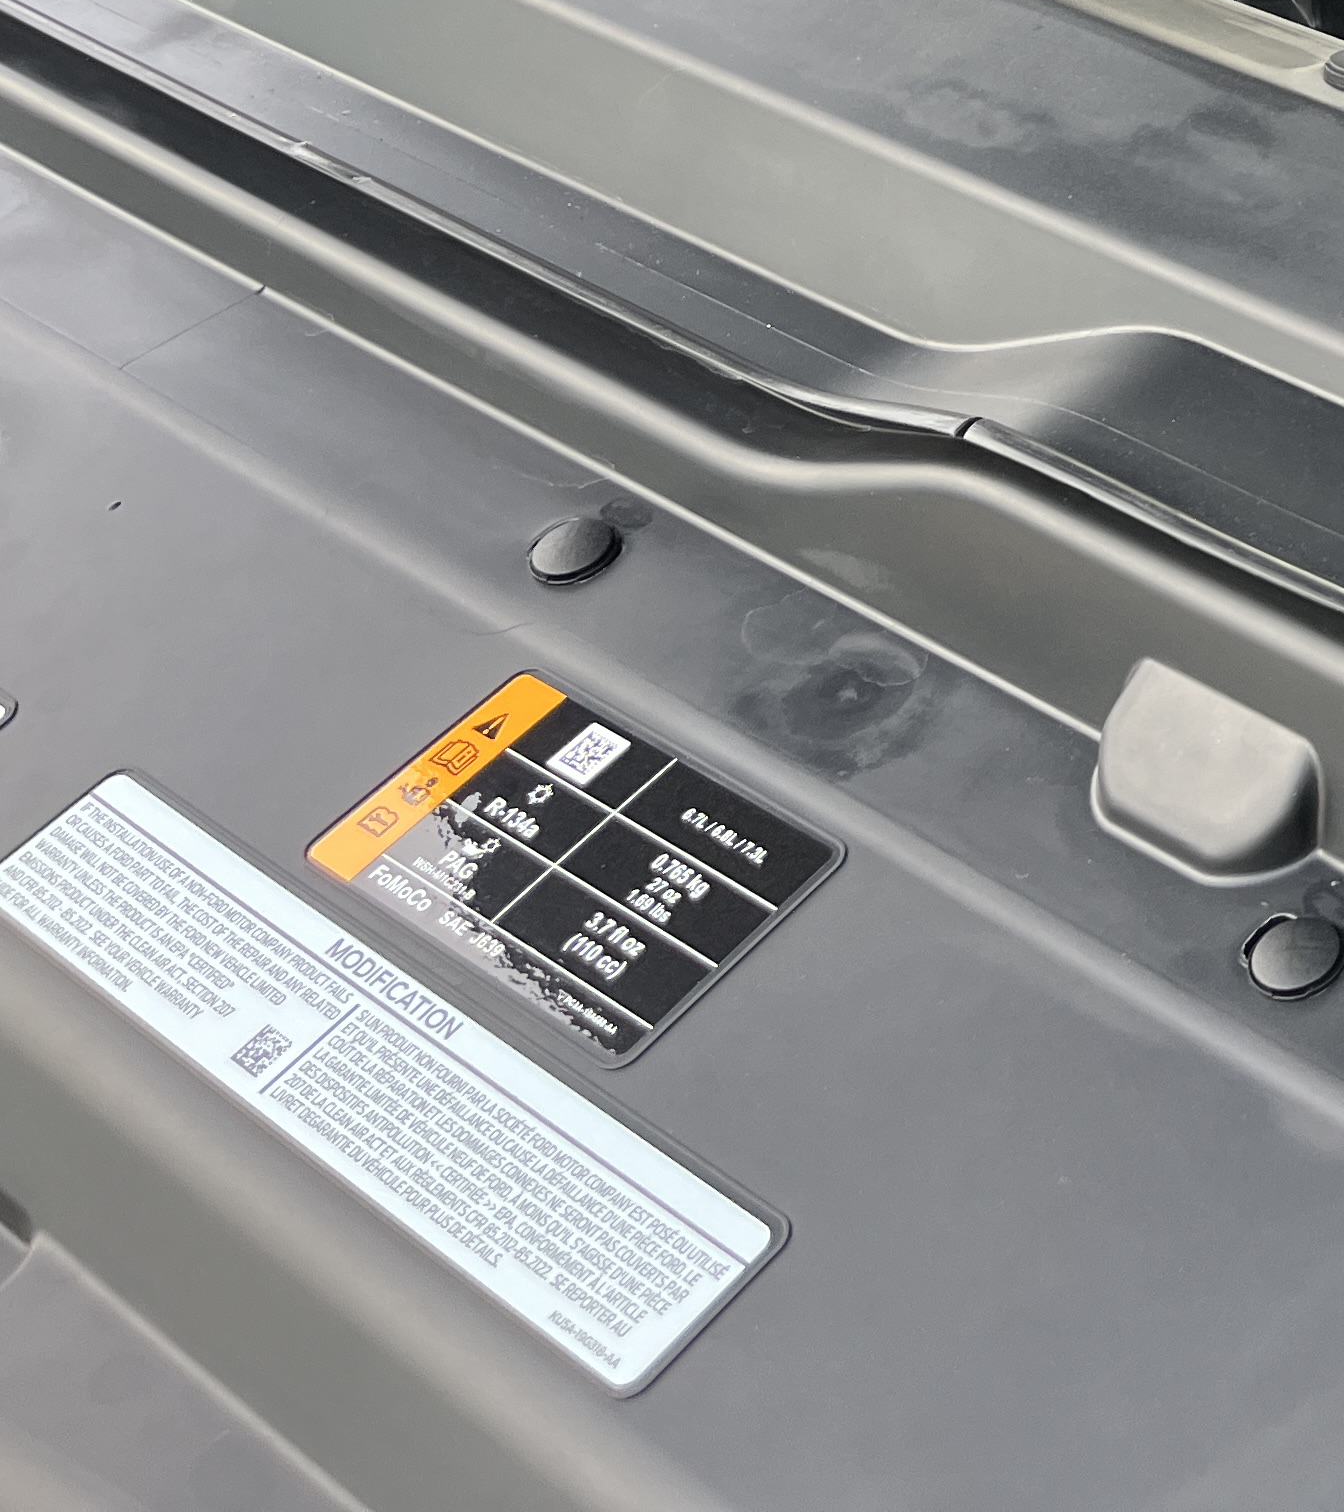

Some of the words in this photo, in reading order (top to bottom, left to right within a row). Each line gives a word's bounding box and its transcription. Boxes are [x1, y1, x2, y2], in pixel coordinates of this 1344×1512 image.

[438, 850, 479, 879] PAG
[484, 797, 542, 838] R-134a
[680, 807, 710, 828] 6.7L
[709, 825, 740, 845] 6.8L
[739, 842, 770, 863] 7.3L
[7, 891, 30, 910] FOR
[21, 904, 42, 922] ALL
[36, 913, 83, 952] WARRANTY
[34, 838, 81, 874] WARRANTY
[73, 868, 108, 896] UNLESS
[101, 888, 123, 908] THE
[115, 900, 158, 932] PRODUCT
[168, 940, 190, 960] EPA
[49, 825, 87, 855] DAMAGE
[79, 847, 102, 869] WILL
[95, 861, 120, 879] NOT
[121, 880, 161, 912] COVERED
[165, 913, 188, 932] THE
[179, 925, 208, 947] FORD
[199, 939, 226, 960] NEW
[219, 952, 258, 984] VEHICLE
[249, 976, 287, 1006] LIMITED
[65, 814, 83, 828] OR
[75, 822, 110, 849] CAUSES
[107, 846, 135, 868] FORD
[127, 861, 156, 882] PART
[176, 896, 200, 916] THE
[191, 908, 220, 930] COST
[222, 930, 246, 950] THE
[237, 942, 273, 970] REPAIR
[264, 963, 289, 982] AND
[282, 975, 308, 995] ANY
[298, 987, 342, 1021] RELATED
[79, 801, 95, 812] IF
[87, 806, 110, 825] THE
[168, 867, 187, 880] OF
[184, 879, 230, 914] NON-FORD
[222, 906, 257, 934] MOTOR
[250, 927, 295, 961] COMPANY
[287, 954, 332, 987] PRODUCT
[323, 980, 355, 1004] FAILS
[368, 863, 435, 912] FoMoCo
[438, 910, 474, 937] SAE
[468, 929, 505, 957] J639
[624, 889, 653, 910] 1.69
[648, 903, 673, 922] lbs
[645, 877, 666, 894] 27
[660, 888, 681, 903] oz
[649, 853, 694, 884] 0.765
[683, 875, 712, 899] kg
[2, 864, 26, 882] AND
[18, 875, 39, 893] CFR
[88, 929, 111, 948] SEE
[103, 940, 131, 964] YOUR
[124, 956, 162, 987] VEHICLE
[153, 979, 204, 1019] WARRANTY
[18, 850, 63, 886] EMISSIONS
[55, 878, 97, 911] PRODUCT
[88, 904, 120, 930] UNDER
[113, 923, 136, 942] THE
[128, 935, 160, 960] CLEAN
[150, 953, 172, 971] AIR
[181, 976, 221, 1008] SECTION
[212, 999, 236, 1018] 207
[560, 932, 603, 962] (110
[595, 953, 628, 980] cc)
[584, 911, 616, 936] 3.7
[607, 926, 628, 943] fl
[619, 936, 645, 956] oz
[325, 938, 463, 1040] MODIFICATION
[269, 1085, 306, 1114] LIVRET
[398, 1185, 432, 1213] POUR
[423, 1203, 455, 1229] PLUS
[298, 1060, 323, 1080] DES
[314, 1072, 370, 1116] DISPOSITIFS
[362, 1109, 435, 1165] ANTIPOLLUTION
[324, 1055, 372, 1093] GARANTIE
[446, 1146, 478, 1171] NEUF
[515, 1198, 553, 1227] MOINS
[375, 1024, 421, 1057] PRODUIT
[411, 1049, 439, 1072] NON
[430, 1063, 470, 1094] FOURNI
[461, 1085, 487, 1108] PAR
[526, 1132, 558, 1158] FORD
[551, 1150, 591, 1182] MOTOR
[583, 1174, 635, 1213] COMPANY
[627, 1205, 655, 1226] EST
[415, 1075, 441, 1097] UNE
[501, 1138, 538, 1168] CAUSE
[283, 1072, 308, 1091] 207
[322, 1101, 355, 1130] CLEAN
[347, 1122, 370, 1140] AIR
[361, 1133, 388, 1152] ACT
[389, 1155, 417, 1176] AUX
[464, 1209, 489, 1230] CFR
[561, 1282, 617, 1327] REPORTER
[434, 1113, 459, 1134] LES
[450, 1125, 507, 1169] DOMMAGES
[499, 1161, 553, 1203] CONNEXES
[558, 1204, 603, 1238] SERONT
[594, 1230, 621, 1253] PAS
[614, 1245, 670, 1289] COUVERTS
[662, 1280, 690, 1304] PAR
